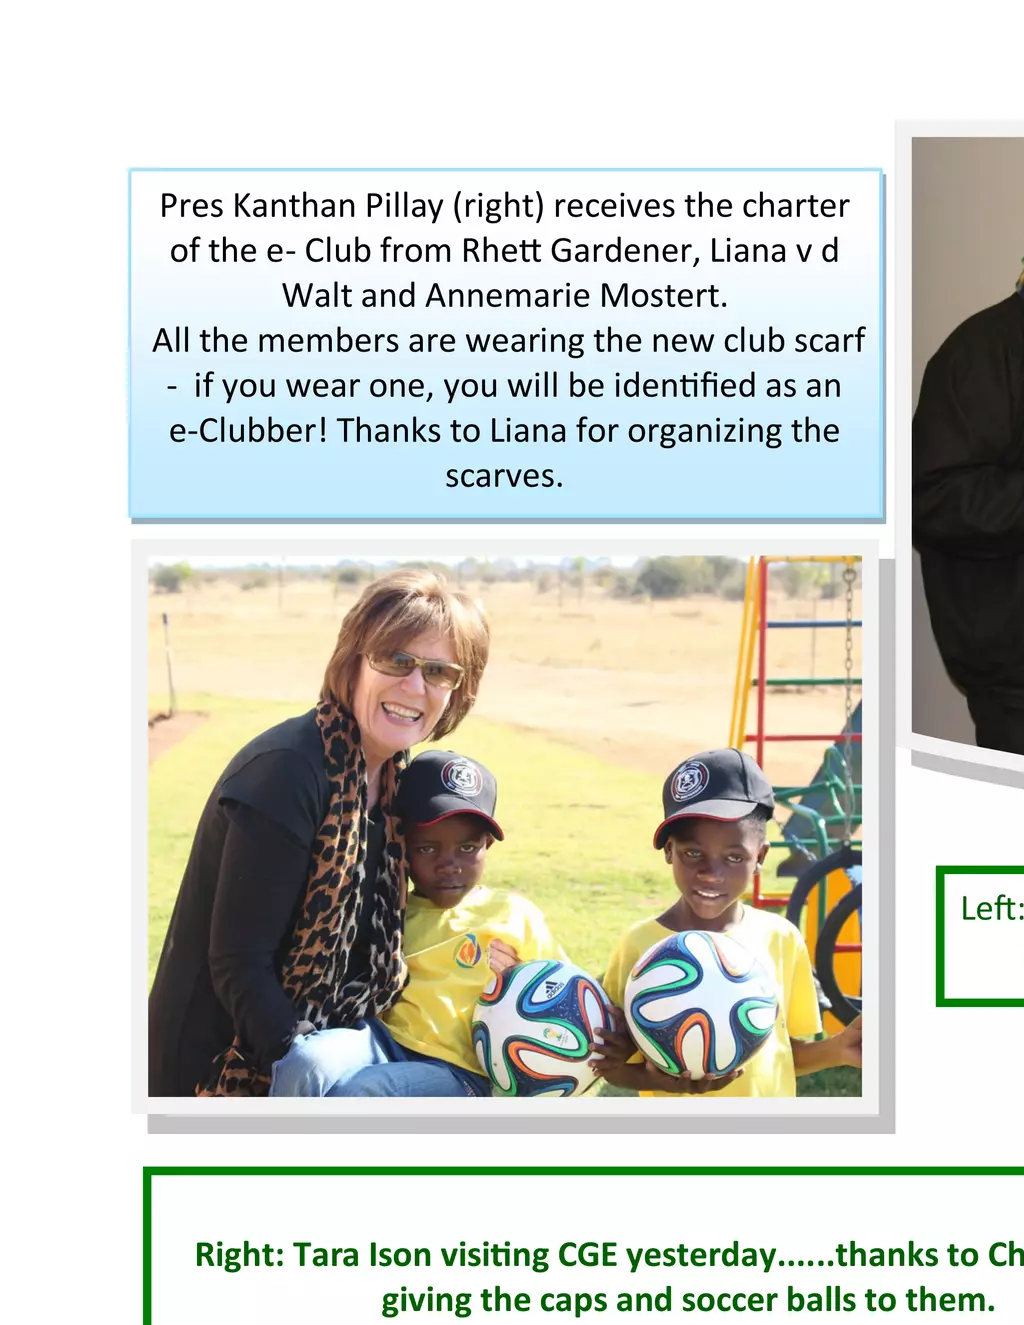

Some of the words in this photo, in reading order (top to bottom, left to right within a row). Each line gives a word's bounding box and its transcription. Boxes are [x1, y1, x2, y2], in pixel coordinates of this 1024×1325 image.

[161, 192, 224, 218] Pres
[234, 191, 355, 218] Kanthan
[367, 191, 444, 224] Pillay
[453, 190, 544, 224] (right)
[555, 192, 675, 218] receives
[684, 191, 733, 218] the
[742, 191, 851, 218] charter
[170, 235, 202, 263] of
[208, 235, 257, 263] the
[267, 243, 296, 263] e-
[305, 235, 371, 263] Club
[379, 235, 451, 263] from
[463, 235, 542, 263] Rhett
[551, 236, 700, 268] Gardener,
[711, 237, 786, 263] Liana
[795, 243, 813, 263] v
[821, 236, 838, 263] d
[281, 280, 353, 308] Walt
[361, 281, 415, 308] and
[425, 282, 590, 308] Annemarie
[601, 282, 727, 308] Mostert.
[152, 325, 189, 353] All
[199, 325, 248, 353] the
[259, 325, 399, 353] members
[408, 333, 456, 353] are
[465, 327, 585, 359] wearing
[593, 325, 642, 353] the
[653, 333, 715, 353] new
[724, 325, 785, 353] club
[794, 325, 867, 353] scarf
[195, 370, 215, 398] if
[221, 378, 276, 404] you
[285, 378, 361, 398] wear
[369, 378, 433, 403] one,
[443, 378, 497, 404] you
[507, 370, 558, 398] will
[569, 370, 605, 398] be
[615, 370, 756, 398] identified
[766, 378, 797, 398] as
[806, 378, 841, 398] an
[169, 415, 326, 443] e-Clubber!
[336, 415, 441, 443] Thanks
[449, 419, 481, 443] to
[491, 417, 566, 443] Liana
[575, 415, 620, 443] for
[628, 417, 783, 449] organizing
[790, 415, 840, 443] the
[445, 468, 563, 488] scarves.
[962, 893, 1024, 921] Left:
[196, 1240, 284, 1274] Right:
[292, 1241, 359, 1268] Tara
[370, 1241, 431, 1268] Ison
[440, 1240, 550, 1274] visiting
[558, 1241, 618, 1267] CGE
[946, 1243, 979, 1268] to
[381, 1285, 473, 1319] giving
[479, 1285, 531, 1313] the
[540, 1292, 608, 1319] caps
[616, 1285, 672, 1313] and
[682, 1292, 779, 1313] soccer
[787, 1285, 857, 1313] balls
[864, 1288, 897, 1313] to
[905, 1285, 995, 1313] them.
